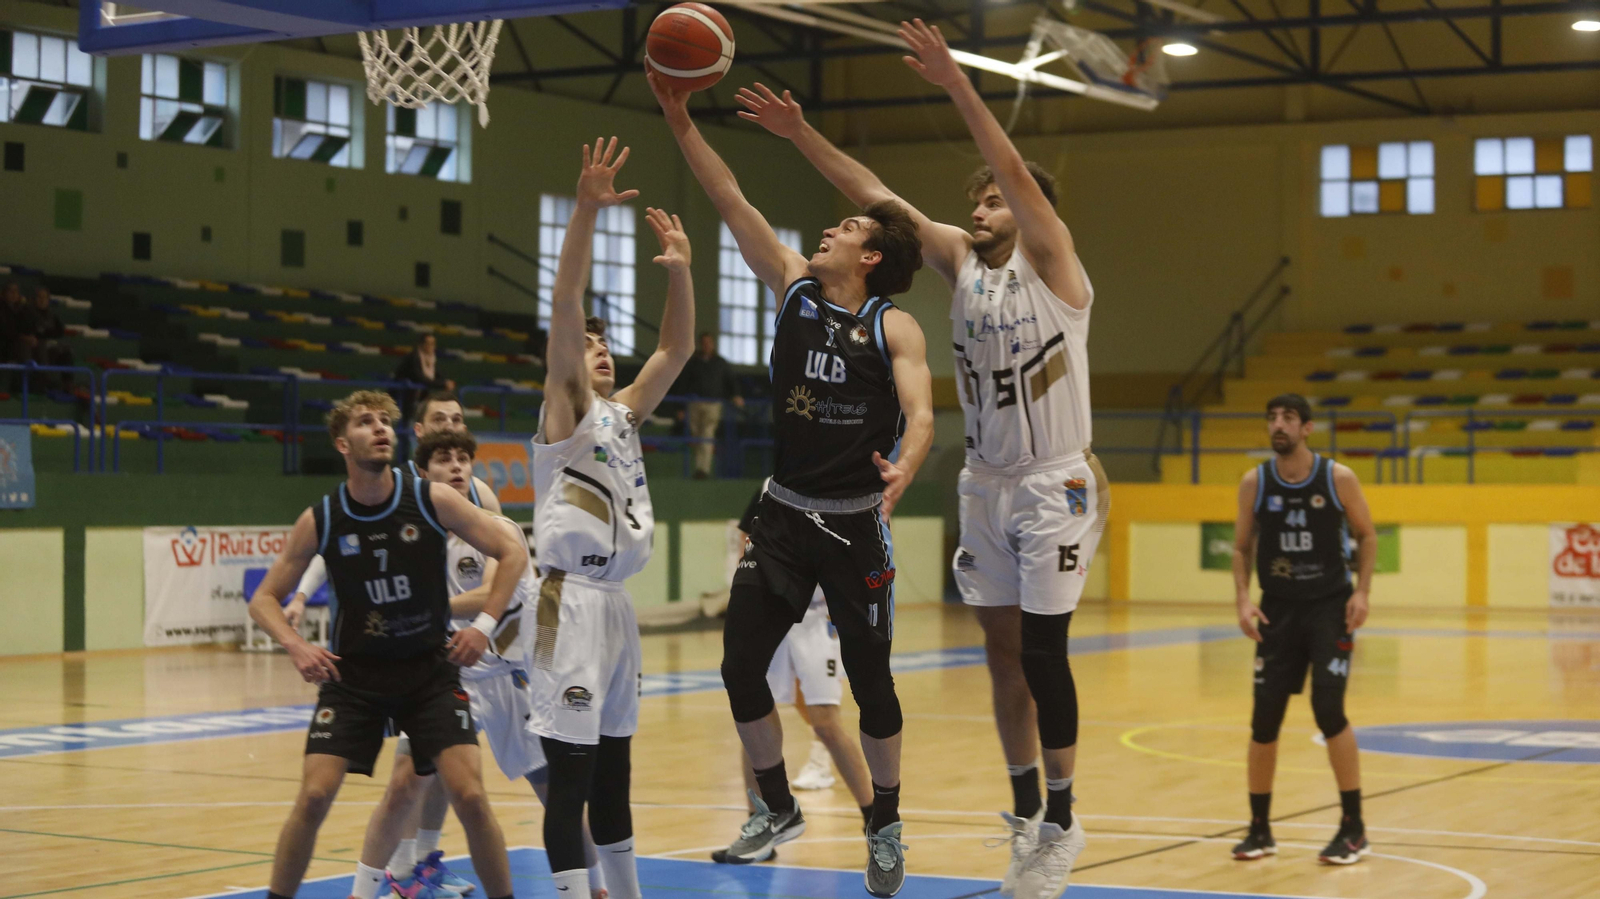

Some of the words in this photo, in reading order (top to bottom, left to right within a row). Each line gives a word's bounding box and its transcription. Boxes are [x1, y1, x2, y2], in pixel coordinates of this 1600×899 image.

[805, 350, 846, 383] ULB
[1285, 509, 1306, 527] 44
[218, 533, 254, 556] Ruiz
[1280, 531, 1313, 551] ULB
[373, 548, 388, 572] 7
[1058, 544, 1080, 572] 15
[365, 575, 412, 604] ULB
[868, 603, 879, 626] 11
[826, 659, 836, 677] 9
[1327, 658, 1348, 676] 44
[455, 710, 469, 729] 7
